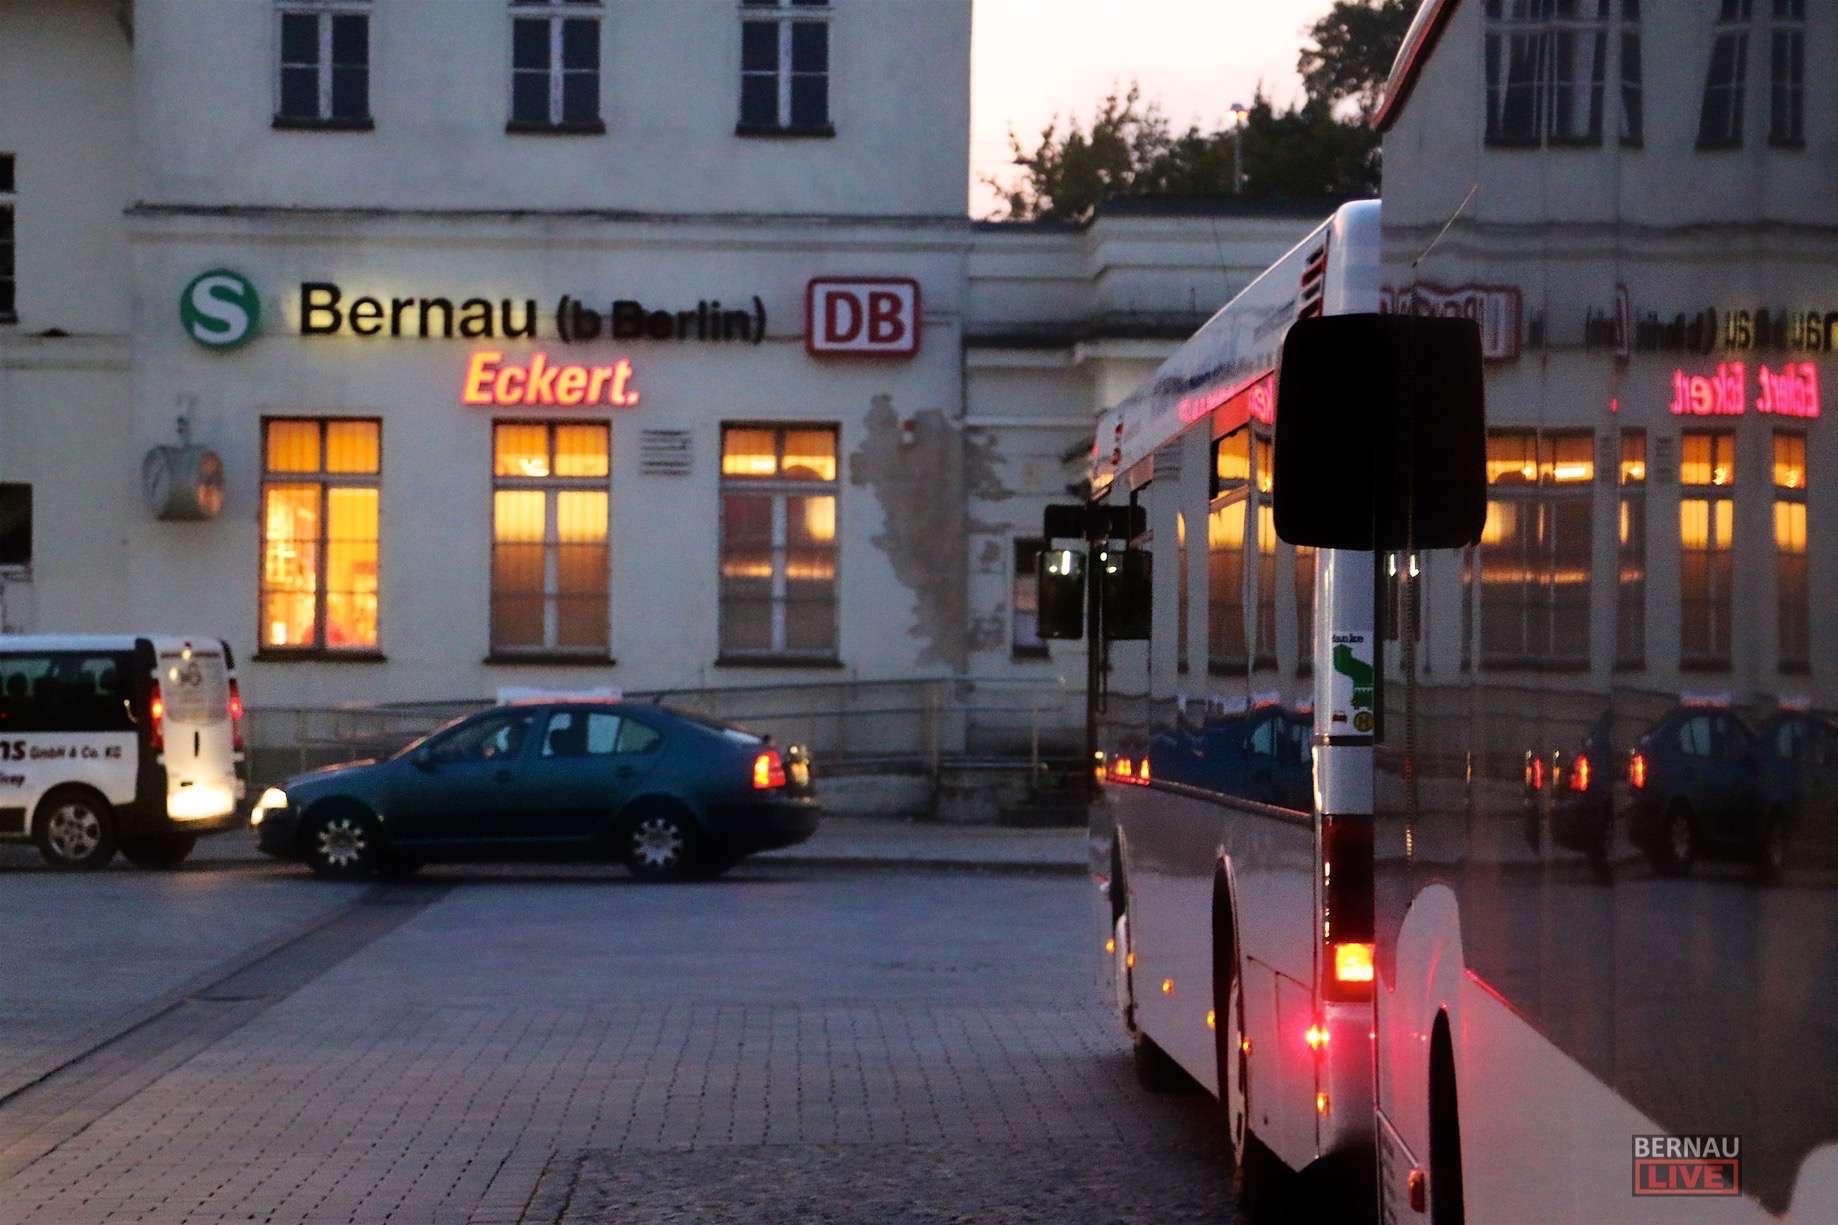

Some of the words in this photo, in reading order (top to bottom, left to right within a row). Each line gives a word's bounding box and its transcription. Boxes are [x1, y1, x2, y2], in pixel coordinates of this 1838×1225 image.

[192, 275, 248, 343] S
[301, 281, 537, 338] Bernau
[556, 294, 600, 344] (b
[612, 294, 767, 345] Berlin)
[824, 291, 905, 343] DB
[461, 350, 641, 406] Eckert.
